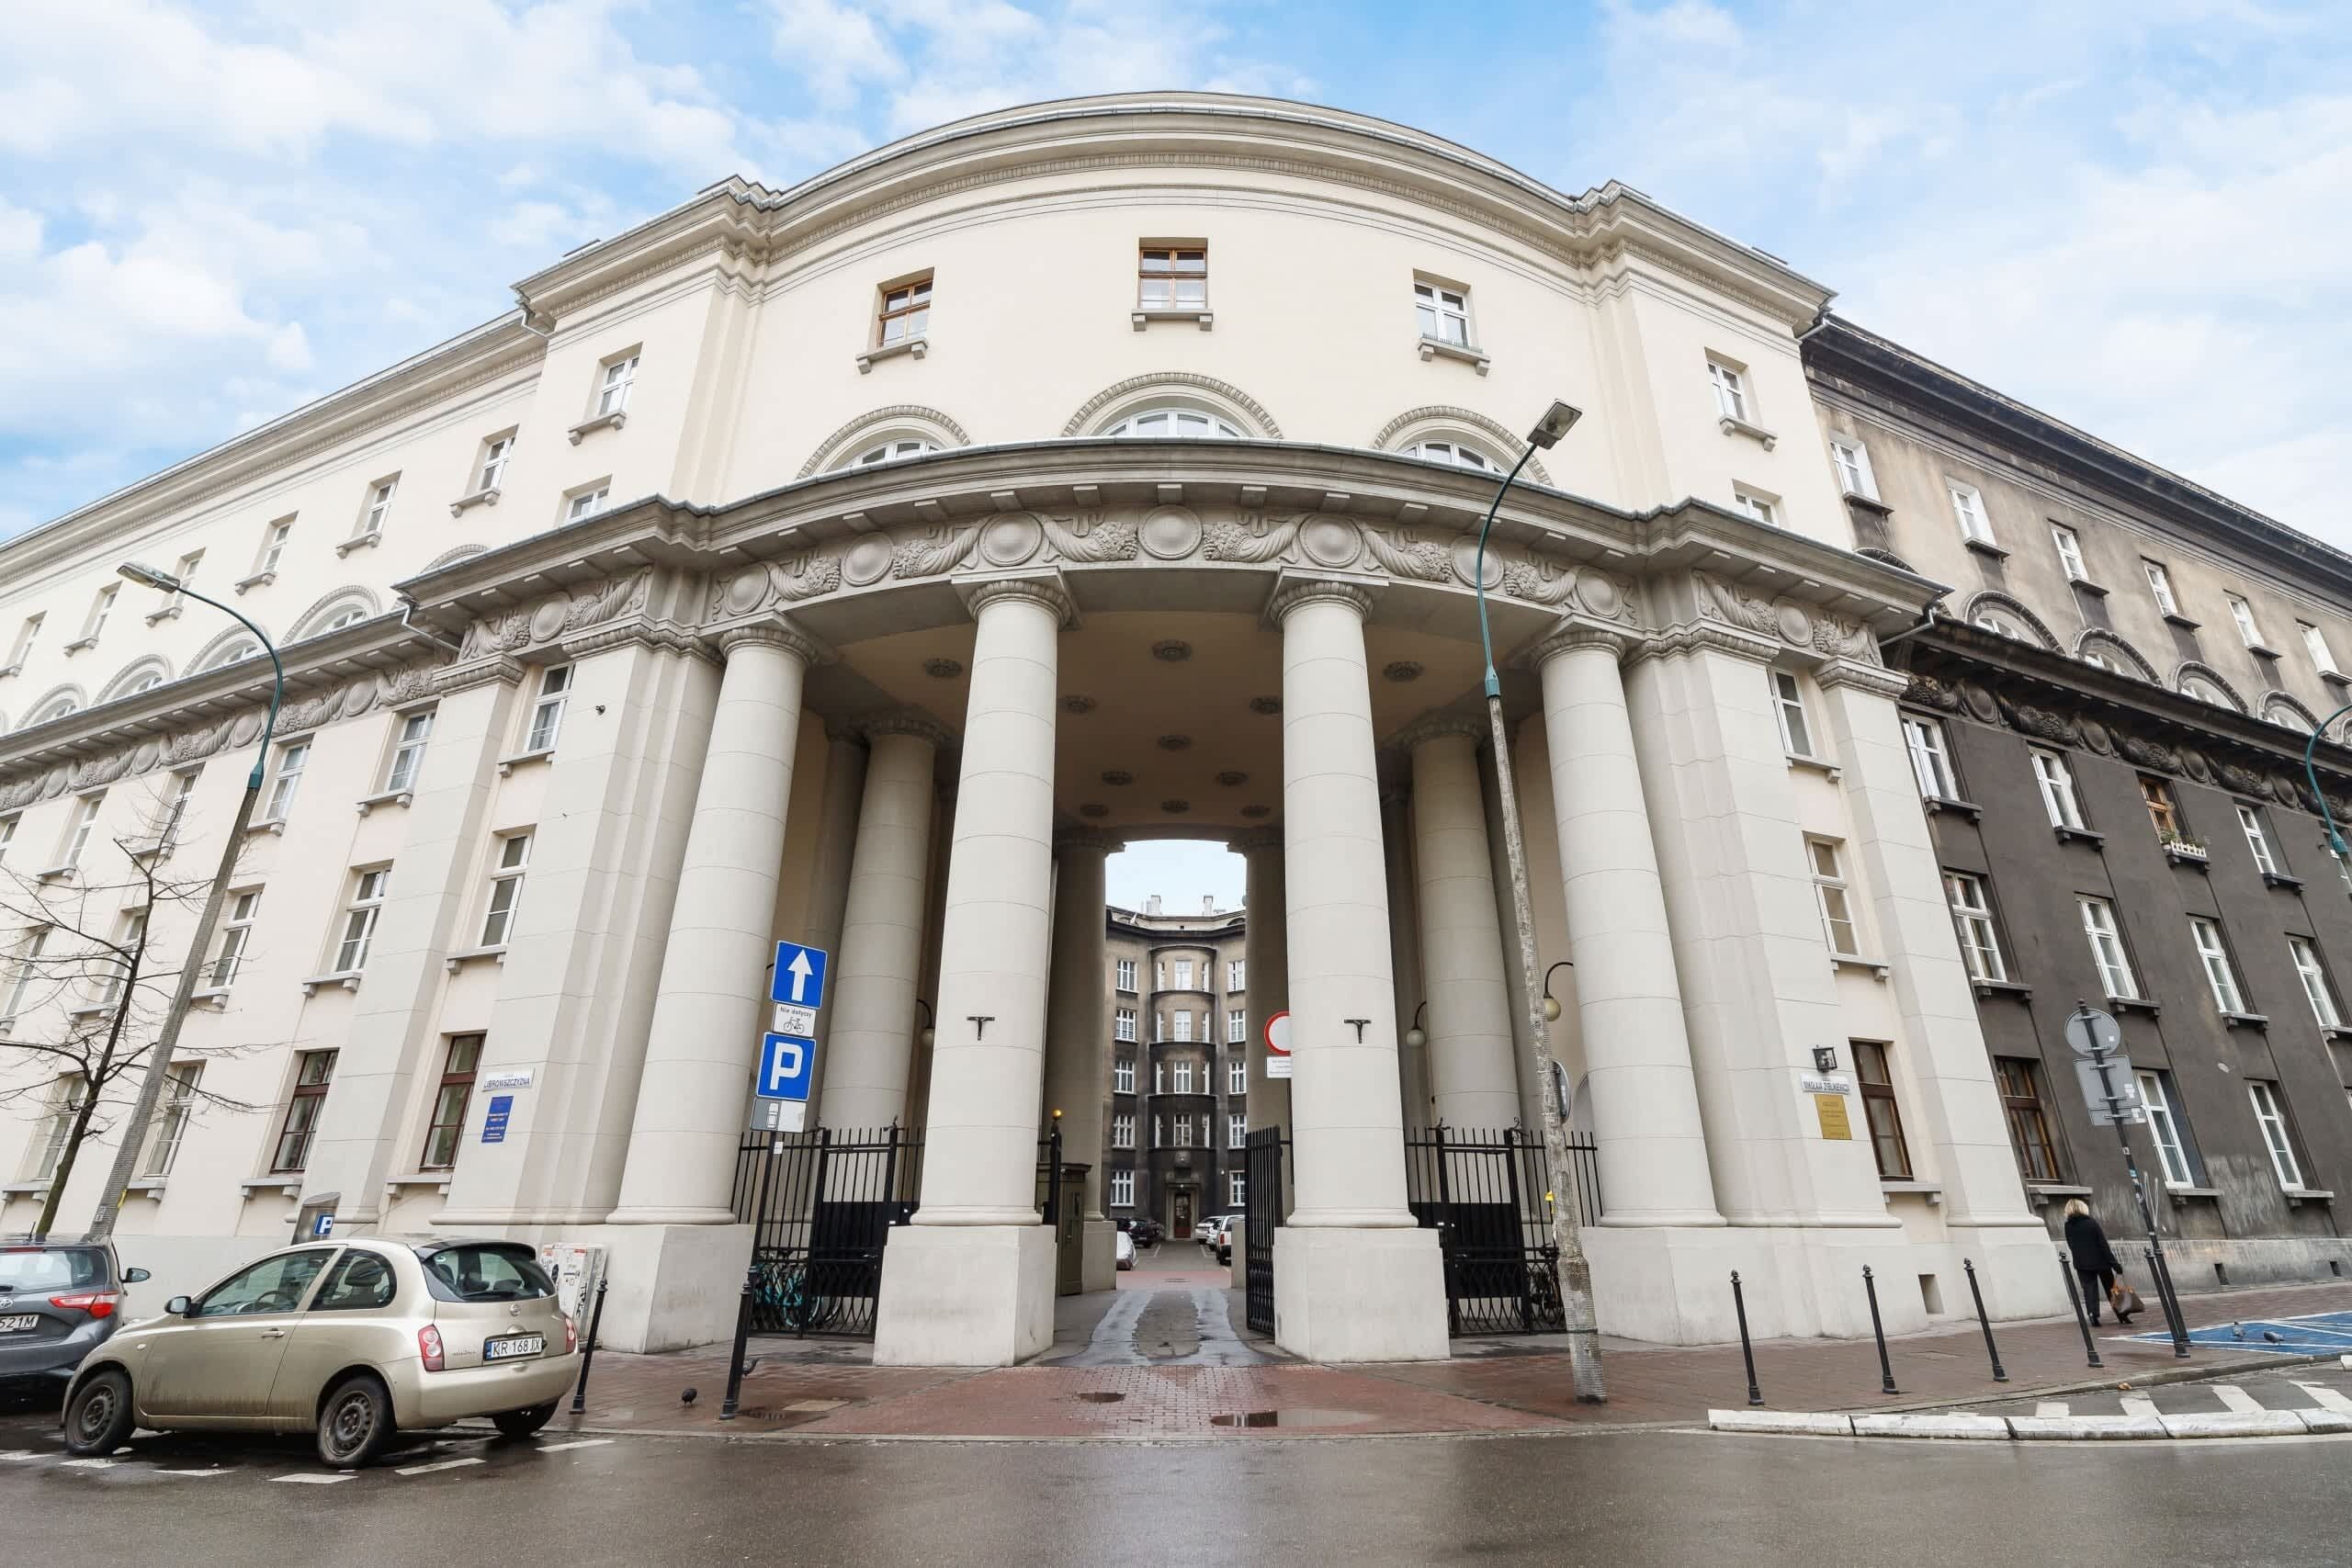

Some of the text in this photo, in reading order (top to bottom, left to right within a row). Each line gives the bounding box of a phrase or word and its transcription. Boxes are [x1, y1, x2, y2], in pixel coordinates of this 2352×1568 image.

[791, 1009, 811, 1019] dotyczy
[769, 1042, 803, 1090] P
[319, 1216, 334, 1234] P
[493, 1341, 508, 1356] KR
